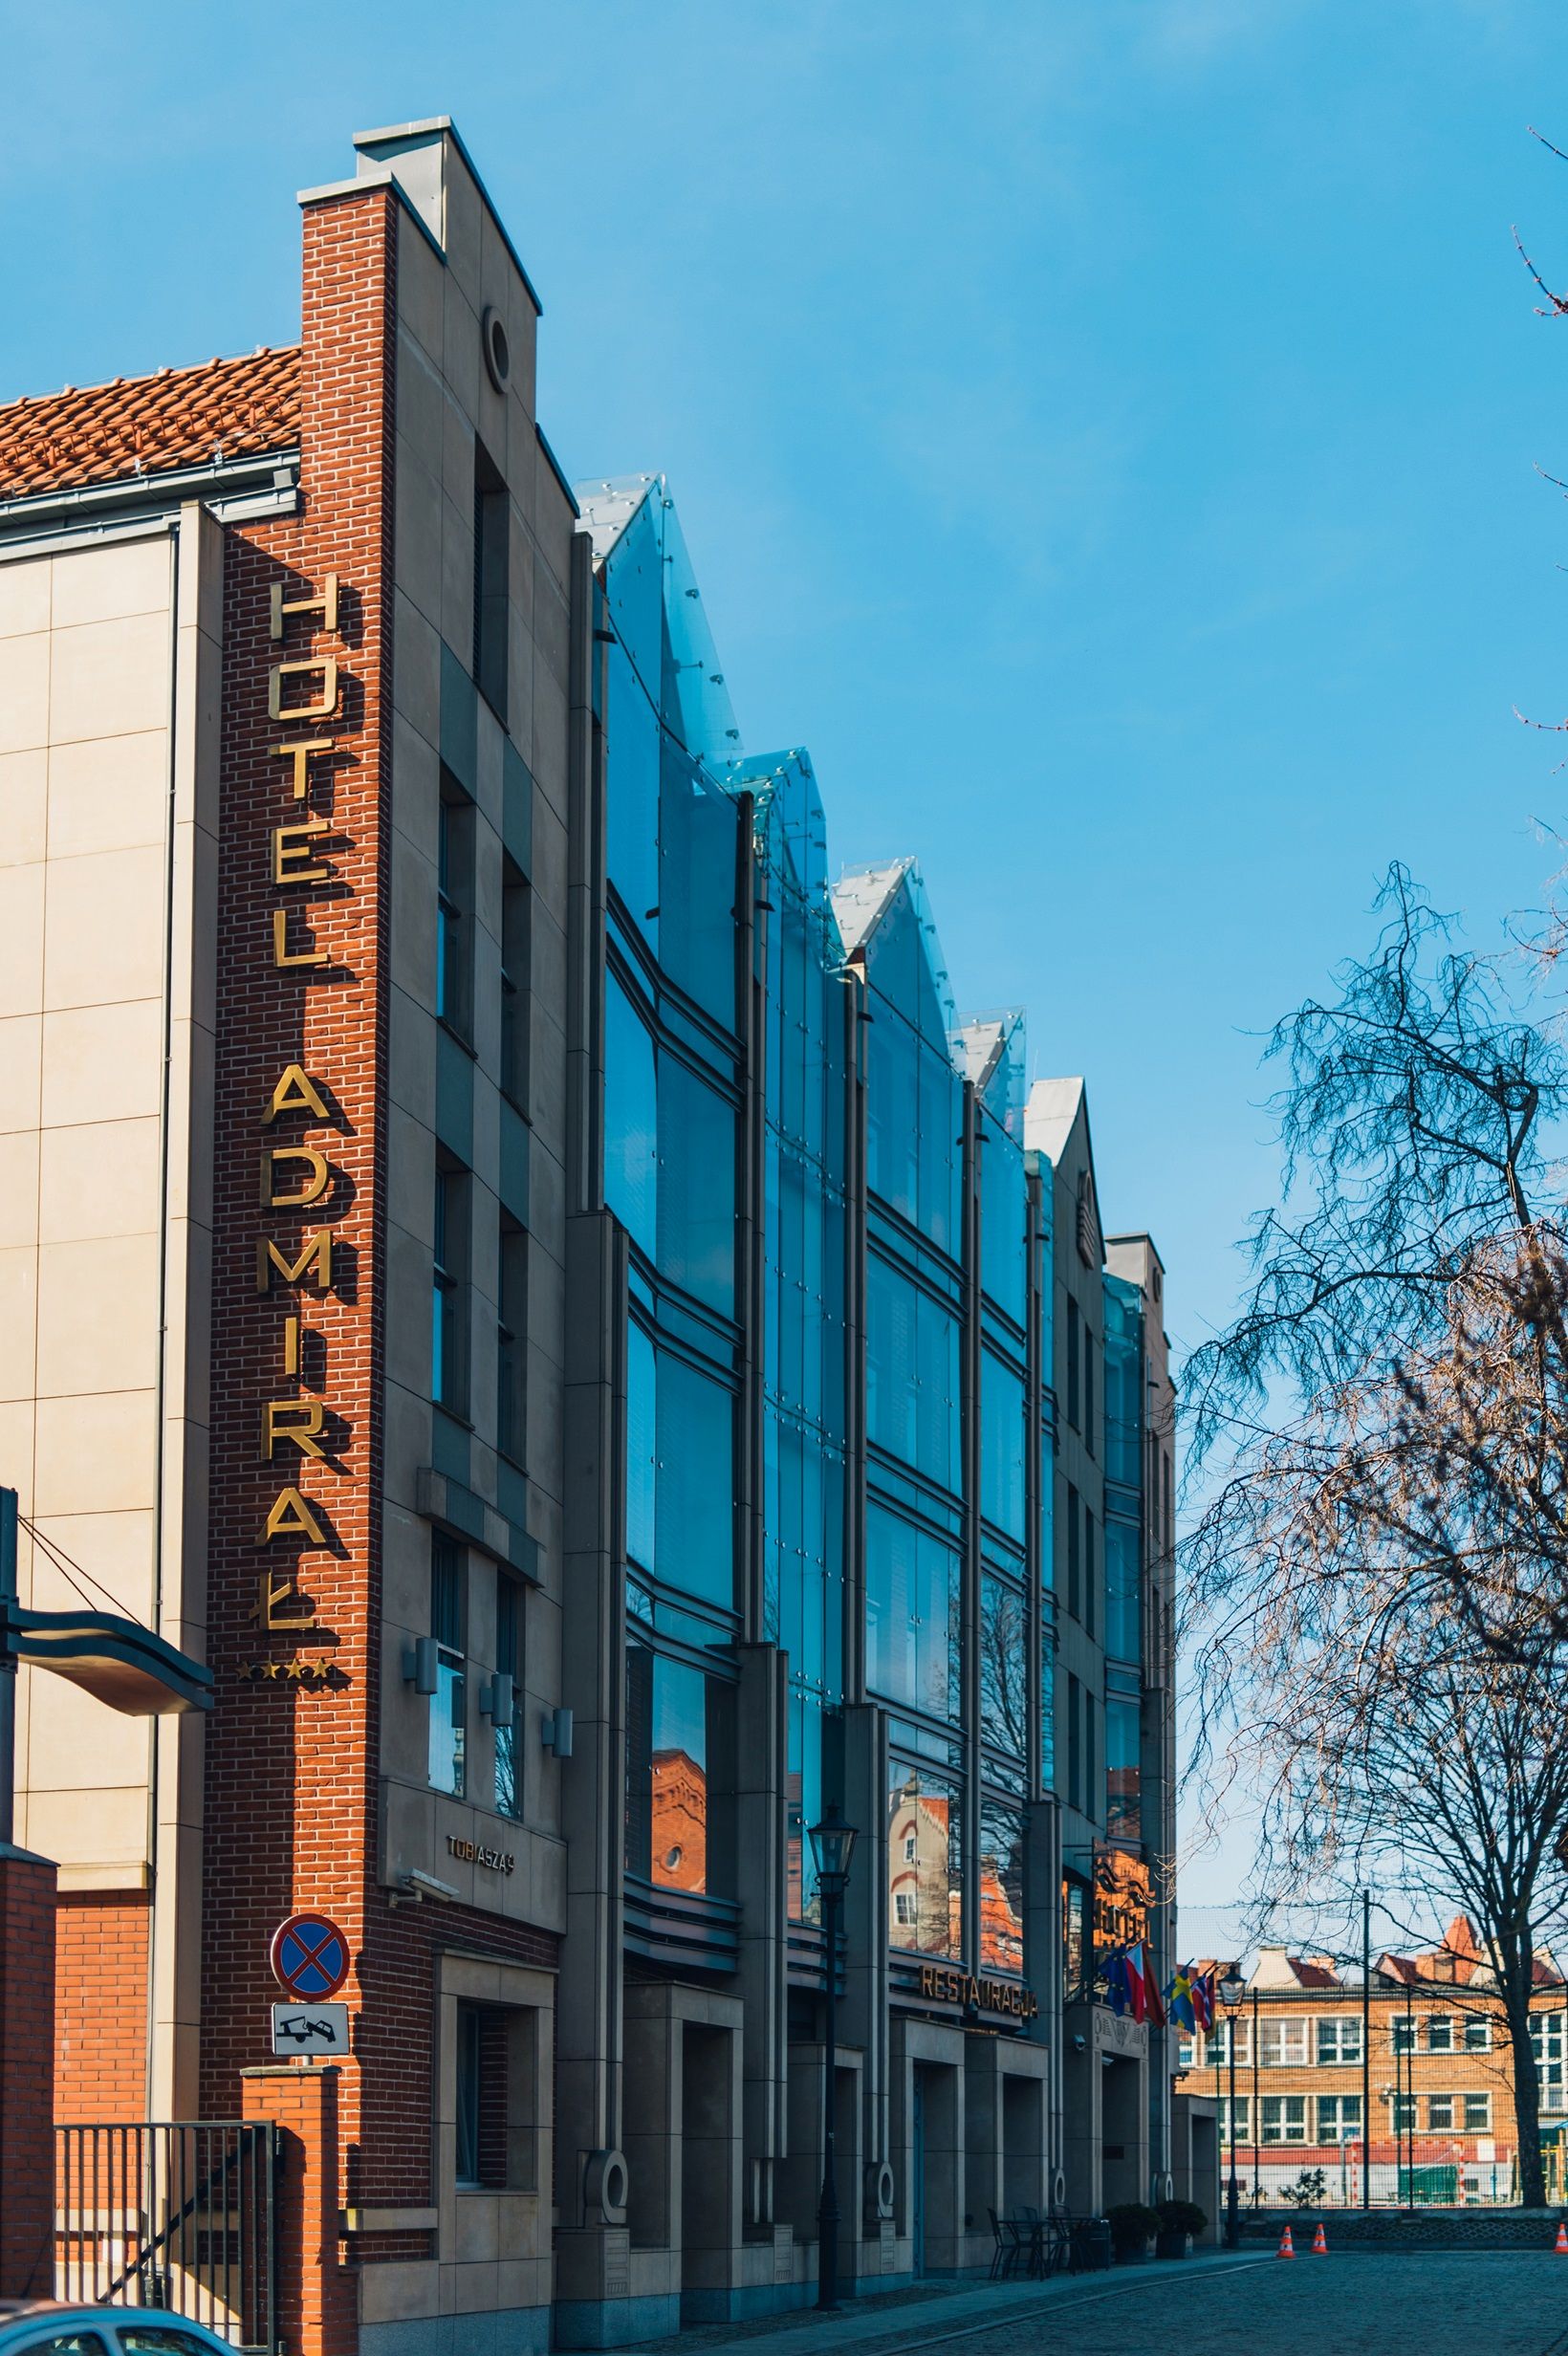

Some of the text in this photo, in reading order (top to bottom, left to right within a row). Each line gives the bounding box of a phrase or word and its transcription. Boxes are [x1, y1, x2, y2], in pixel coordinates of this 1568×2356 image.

[250, 573, 338, 1630] HOTEL ADMIRAŁ
[447, 1835, 507, 1872] TOBIASZA
[920, 1965, 1038, 2018] RESTAURACJA
